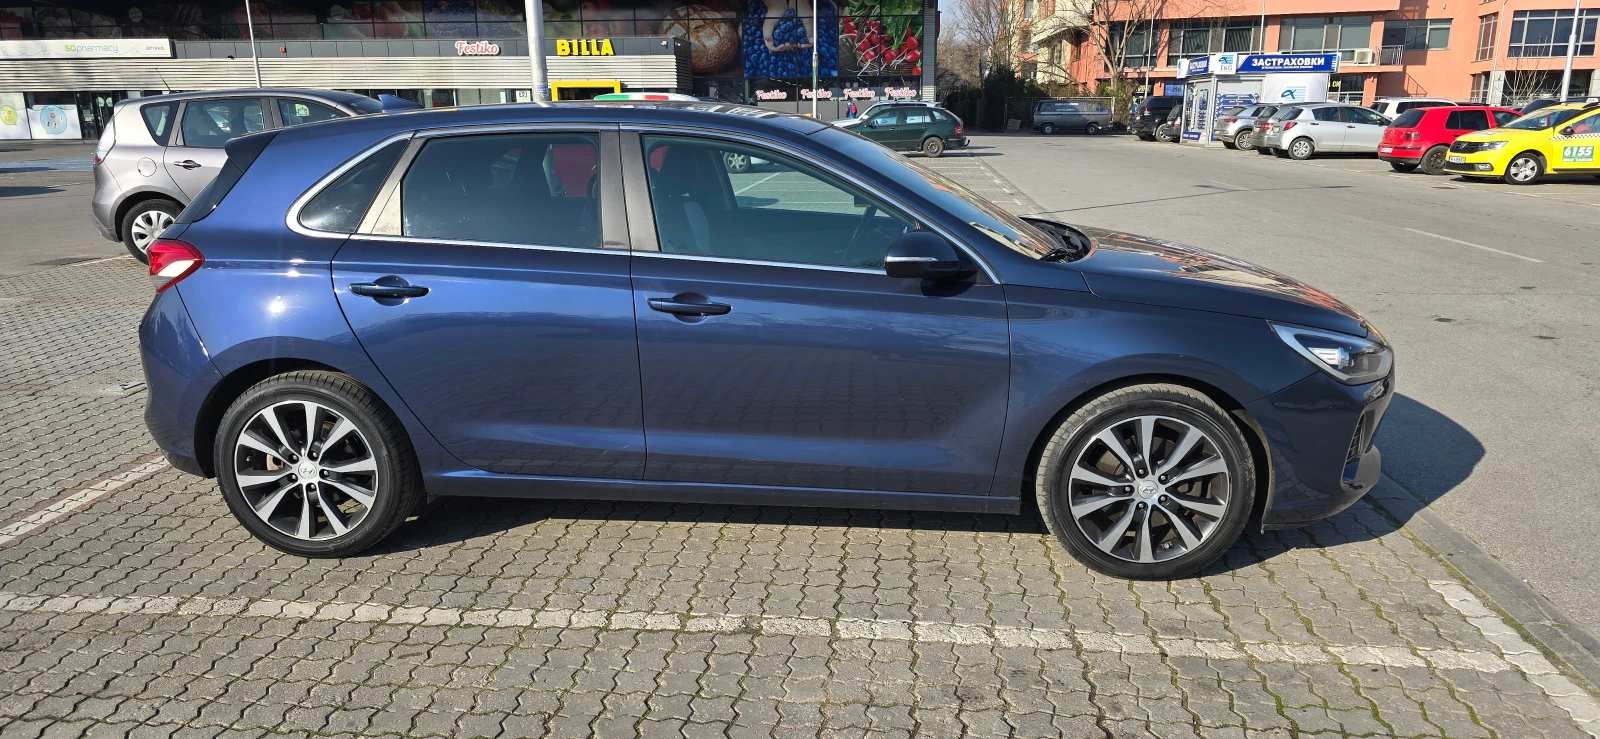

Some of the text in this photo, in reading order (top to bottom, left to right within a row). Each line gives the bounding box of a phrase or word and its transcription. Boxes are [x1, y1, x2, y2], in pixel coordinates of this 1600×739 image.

[455, 40, 499, 56] Festiko
[556, 39, 615, 56] BILLA
[1252, 57, 1325, 67] ЗАСТРАХОВКИ
[1564, 147, 1593, 156] 6155
